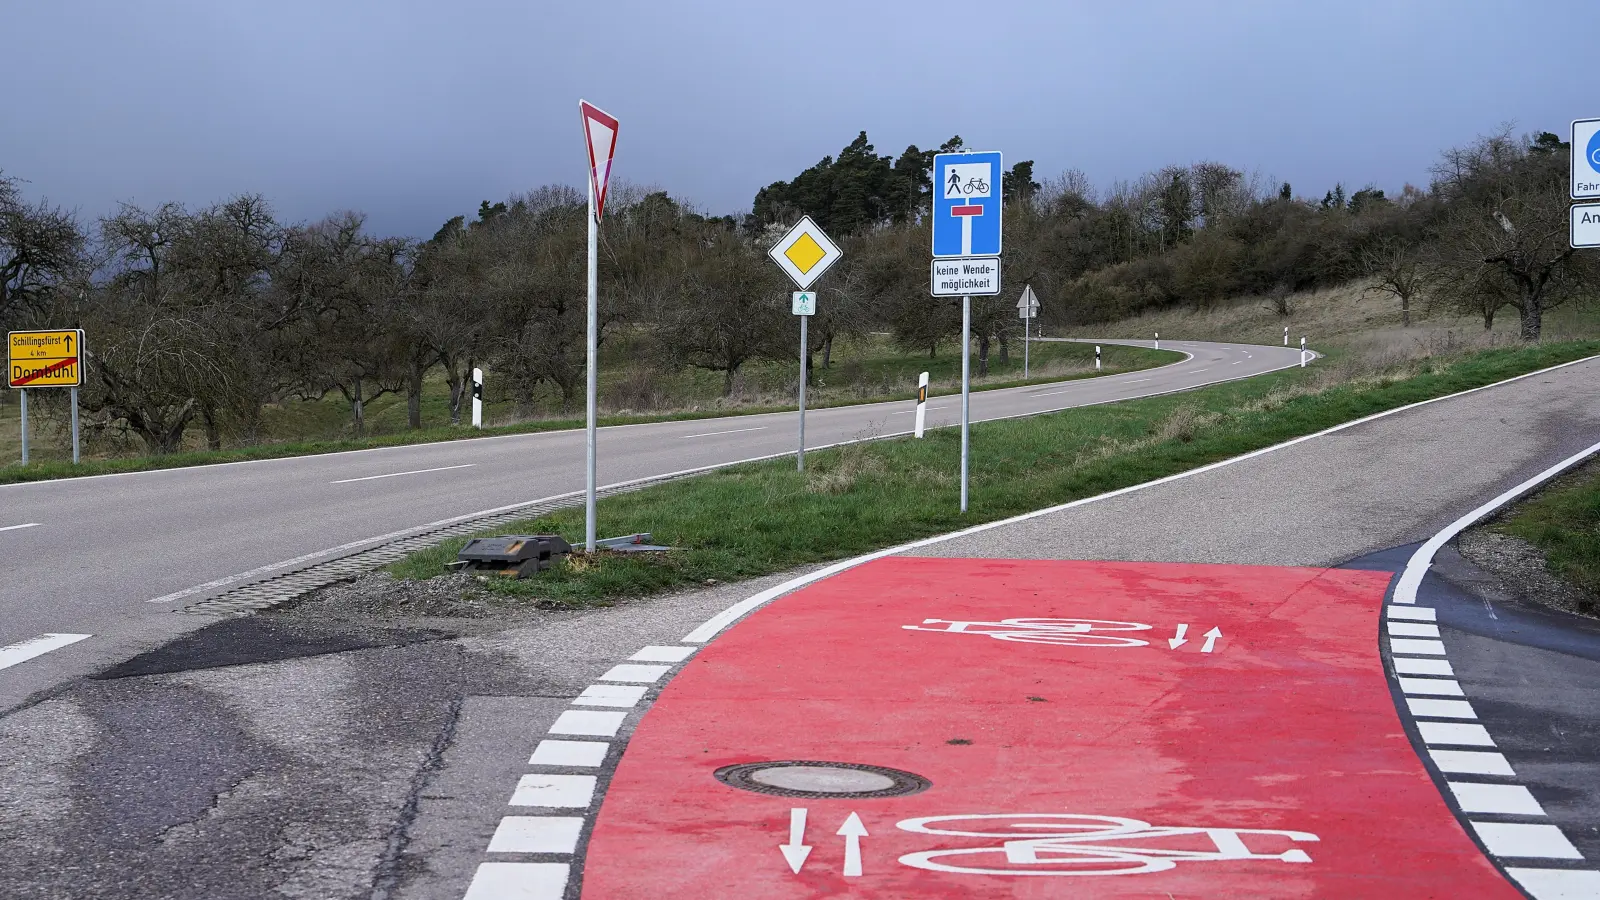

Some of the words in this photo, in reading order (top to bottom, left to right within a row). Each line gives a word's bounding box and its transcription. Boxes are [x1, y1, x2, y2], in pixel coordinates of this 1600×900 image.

[936, 265, 958, 276] keine
[963, 264, 995, 275] Wende-
[941, 278, 990, 291] möglichkeit
[13, 335, 61, 347] Schillingsfürst
[13, 364, 74, 379] Dombühl
